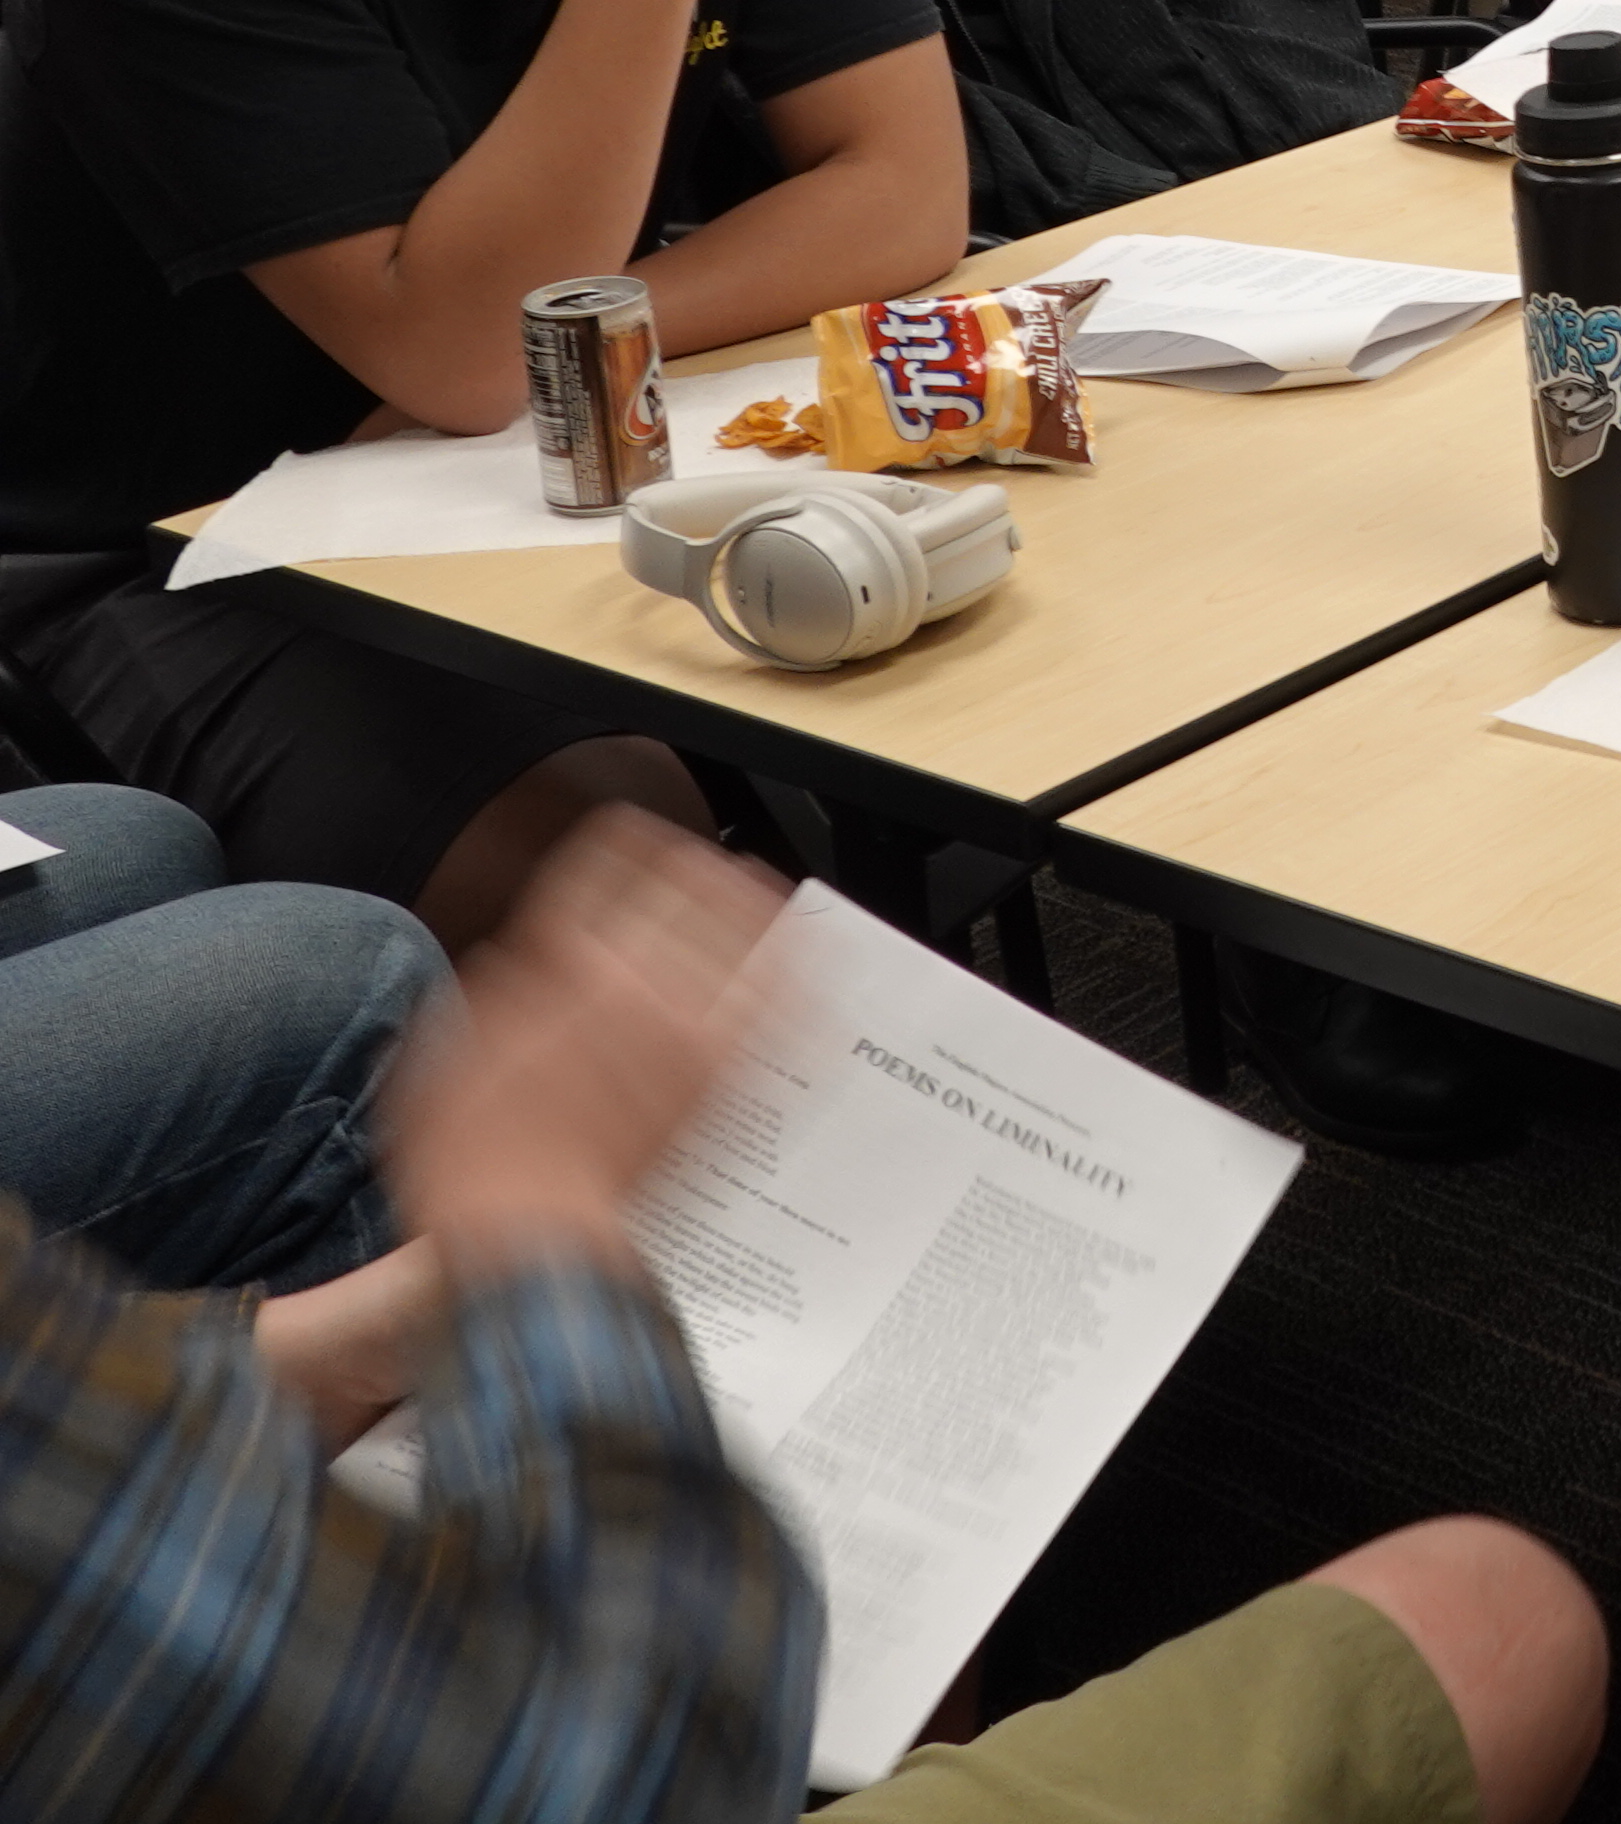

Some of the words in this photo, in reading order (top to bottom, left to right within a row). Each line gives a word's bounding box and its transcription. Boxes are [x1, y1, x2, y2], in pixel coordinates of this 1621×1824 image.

[1038, 356, 1059, 401] CHILI
[851, 1037, 941, 1097] POEMS
[941, 1087, 982, 1120] ON
[980, 1110, 1132, 1200] LIMINALITY
